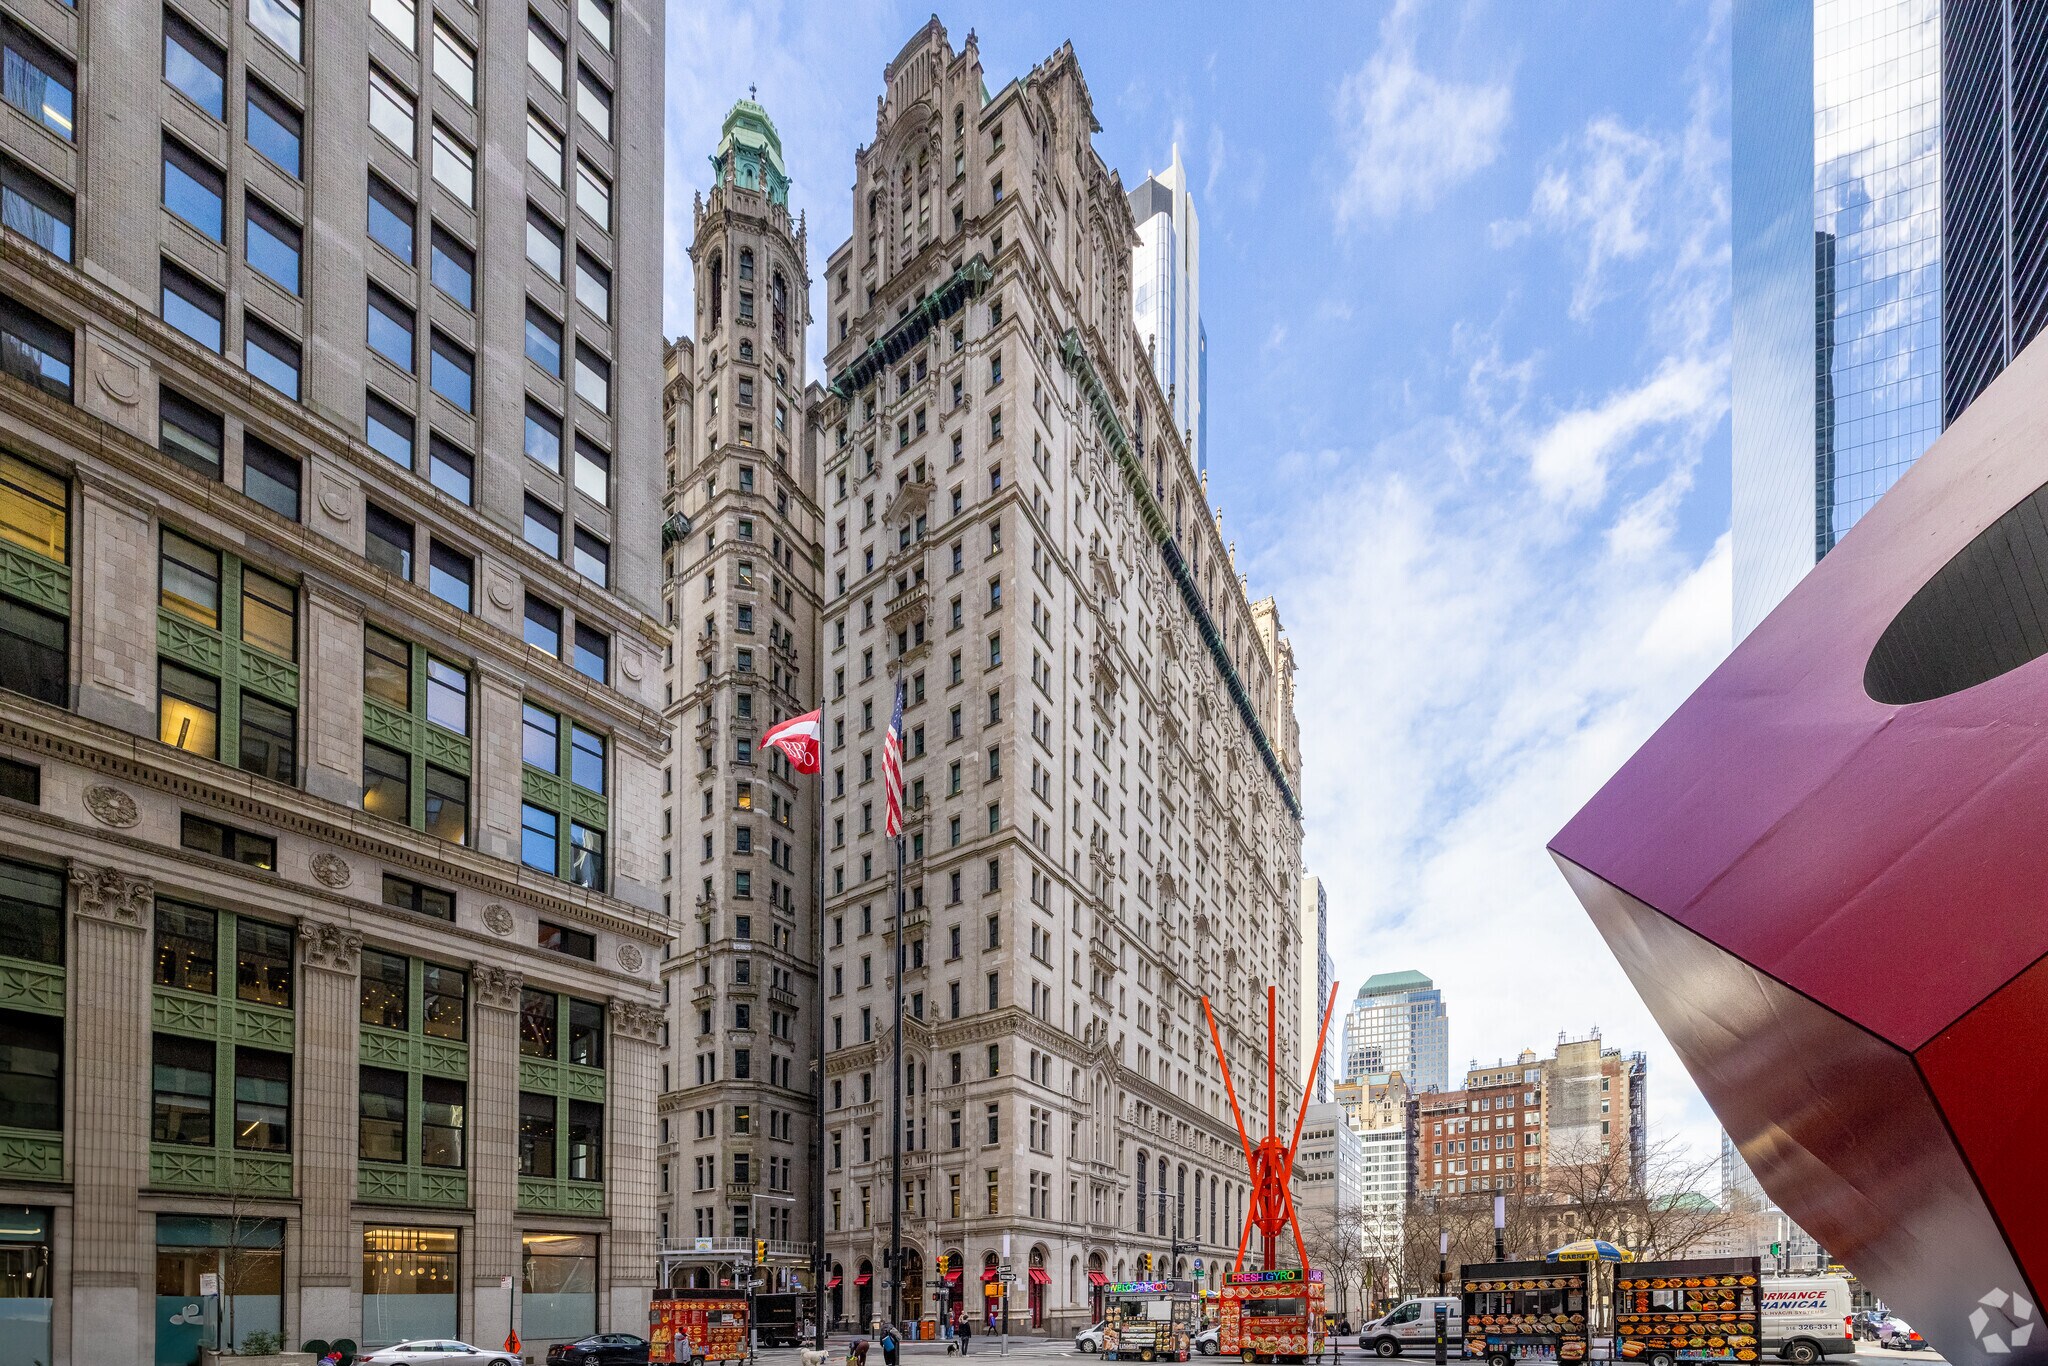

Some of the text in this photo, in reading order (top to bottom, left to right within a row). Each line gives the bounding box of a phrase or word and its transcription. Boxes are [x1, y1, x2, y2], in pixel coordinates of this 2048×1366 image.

[1231, 1271, 1295, 1283] FRESH GYRO
[1798, 1323, 1838, 1331] 326-3311
